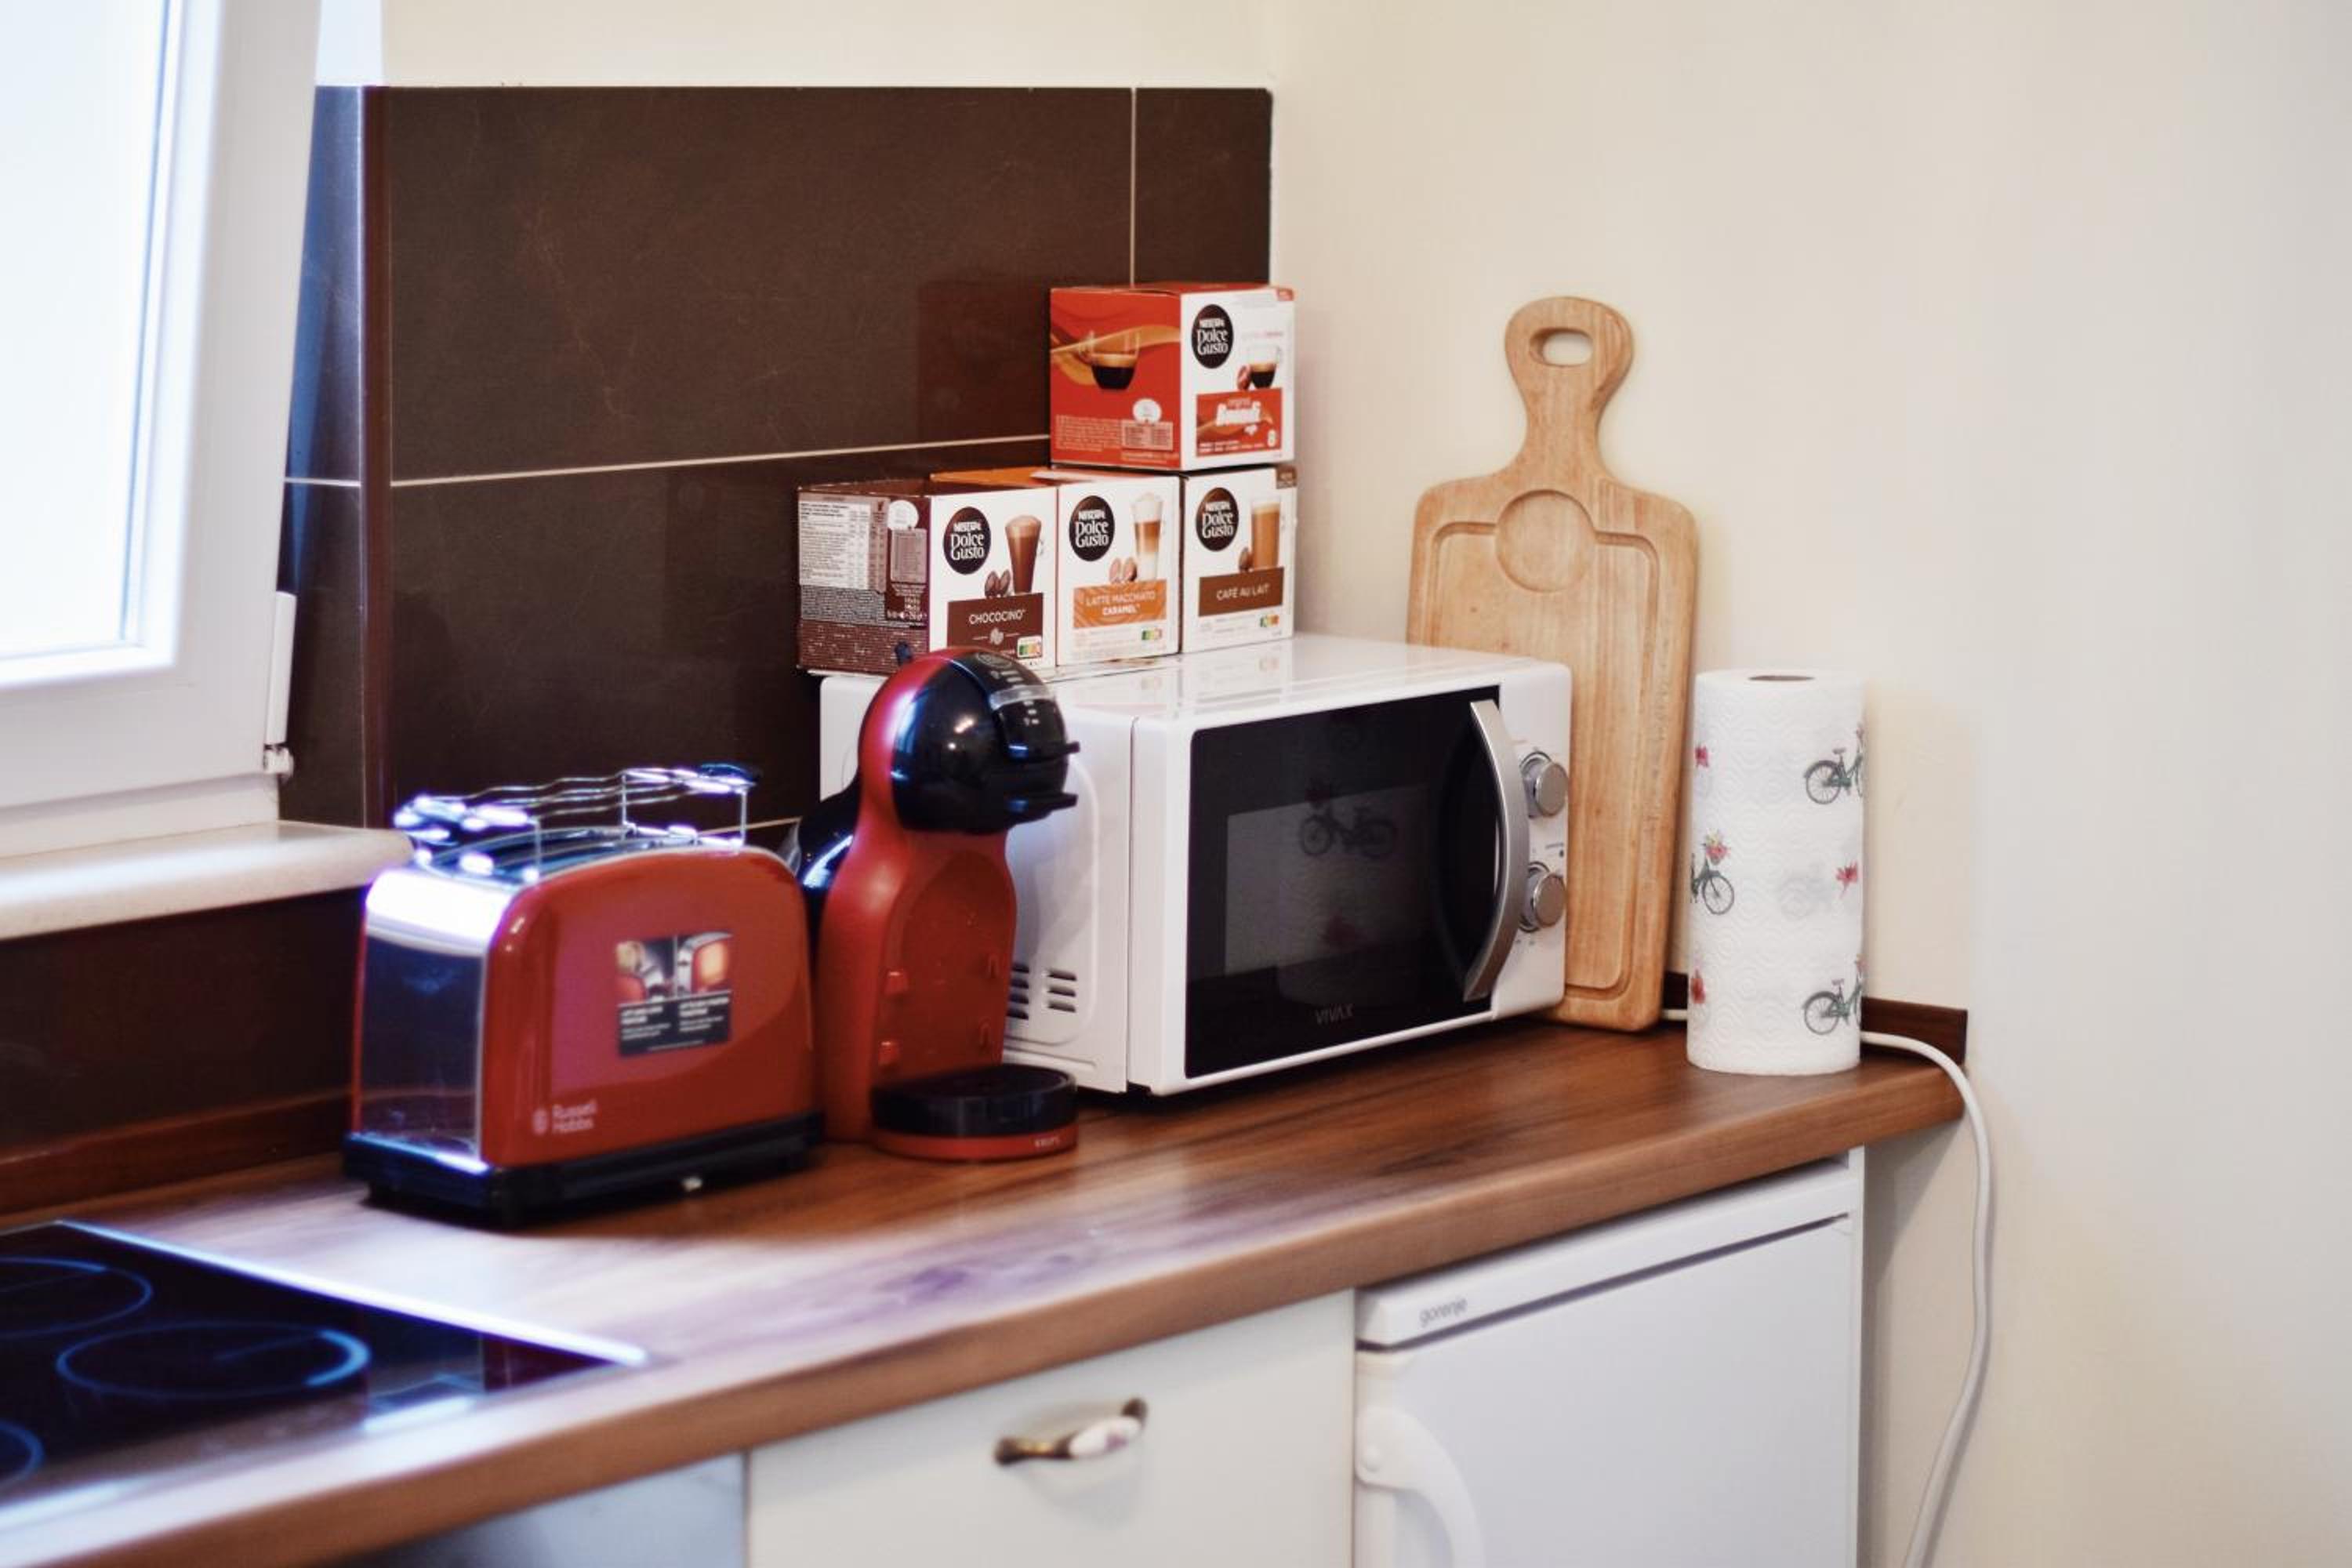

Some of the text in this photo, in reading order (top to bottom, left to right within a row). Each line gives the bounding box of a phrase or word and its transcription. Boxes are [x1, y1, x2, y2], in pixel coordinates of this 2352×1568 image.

[1196, 328, 1229, 343] Dolce
[1196, 343, 1229, 356] Gusto
[1202, 511, 1234, 528] Dolce
[1075, 520, 1109, 535] Dolce
[1202, 524, 1234, 539] Gusto
[951, 532, 985, 549] Dolce
[1075, 534, 1109, 548] Gusto
[951, 546, 985, 561] Gusto
[1240, 587, 1250, 597] AU
[1085, 594, 1110, 608] LATTE
[1315, 1003, 1354, 1025] VIVAX
[1419, 1296, 1468, 1329] gorenje
